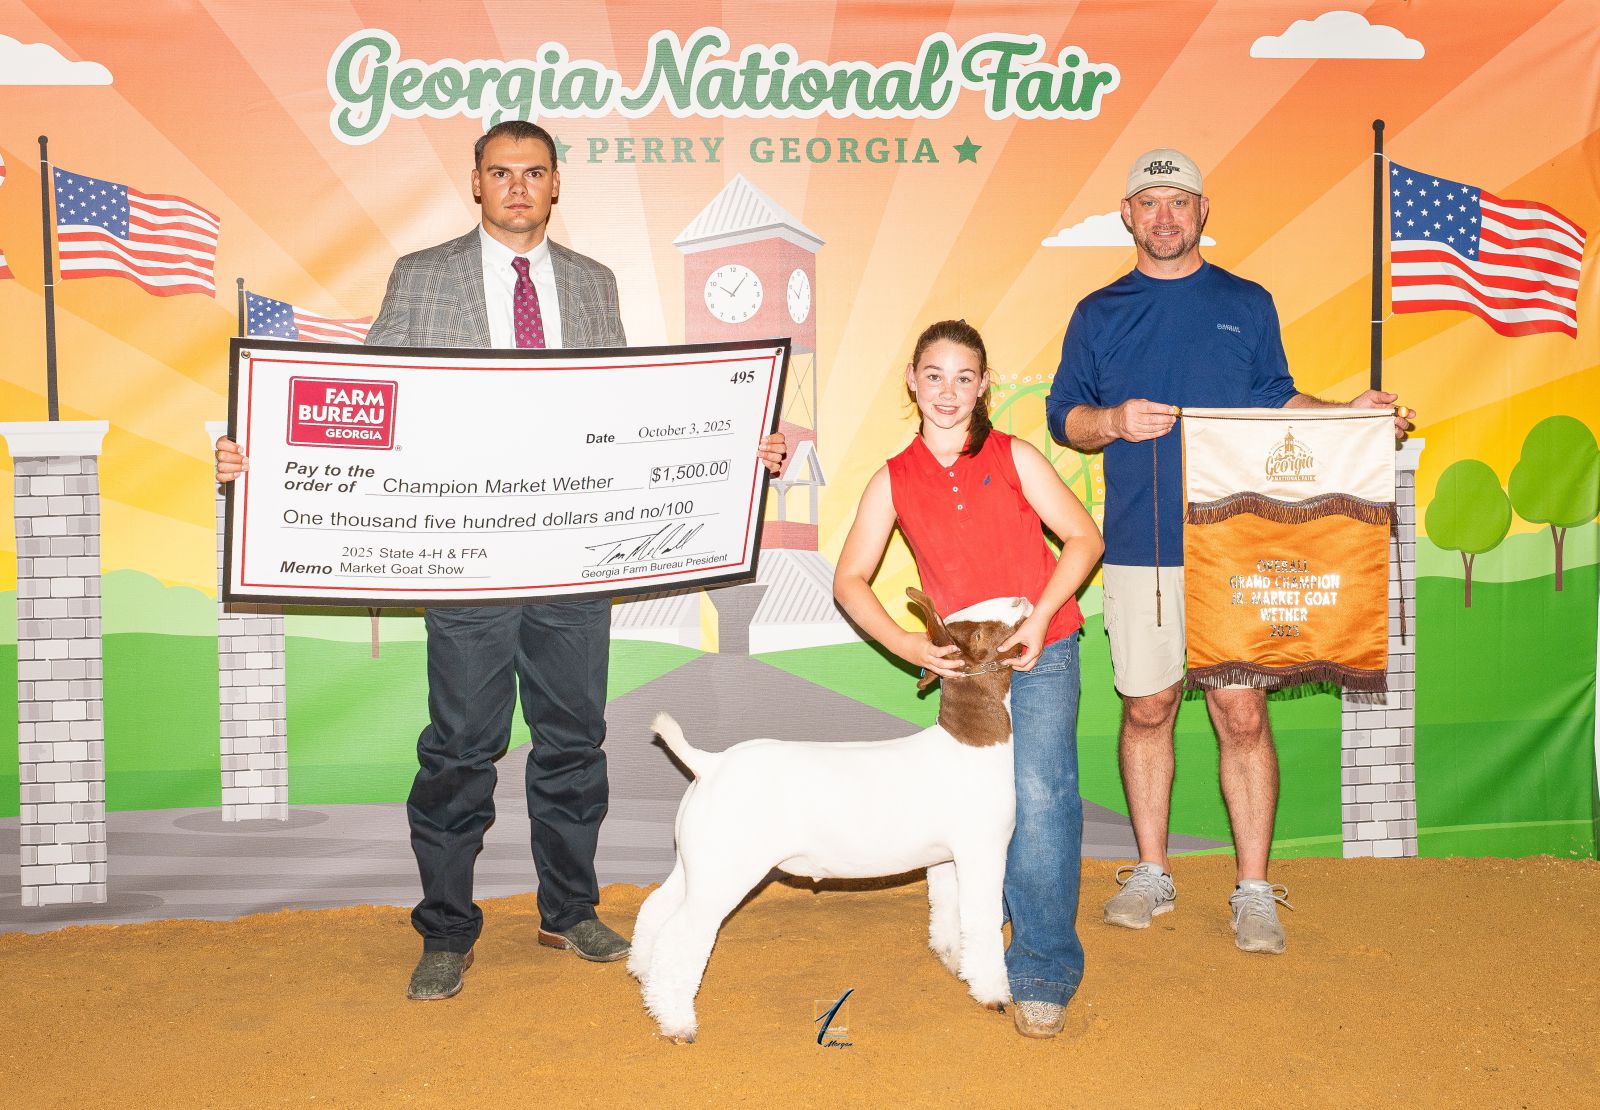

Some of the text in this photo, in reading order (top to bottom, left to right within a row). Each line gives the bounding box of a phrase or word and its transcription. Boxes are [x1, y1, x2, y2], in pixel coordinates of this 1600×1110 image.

[334, 34, 1113, 137] Georgia National Fair
[586, 136, 940, 164] PERRY GEORGIA
[730, 371, 755, 384] 495
[325, 388, 385, 406] FARM
[298, 405, 385, 424] BUREAU
[325, 428, 382, 440] GEORGIA
[586, 419, 732, 444] Date October 3, 2025
[284, 461, 375, 478] Pay to the
[1265, 455, 1314, 481] Georgia
[284, 461, 728, 497] order of Champion Market Wether $1,500.00
[283, 500, 694, 529] One thousand five hundred dollars and no/100
[341, 547, 488, 559] 2025 State 4-H & FFA
[280, 561, 464, 575] Memo Market Goat Show
[581, 553, 728, 579] Georgia Farm Bureau President
[1256, 559, 1311, 573] OVERALL
[1229, 574, 1340, 589] GRAND CHAMPION
[1251, 590, 1301, 605] MARKET
[1305, 591, 1338, 606] GOAT
[1260, 607, 1308, 622] WETHER
[1270, 624, 1300, 637] 2025
